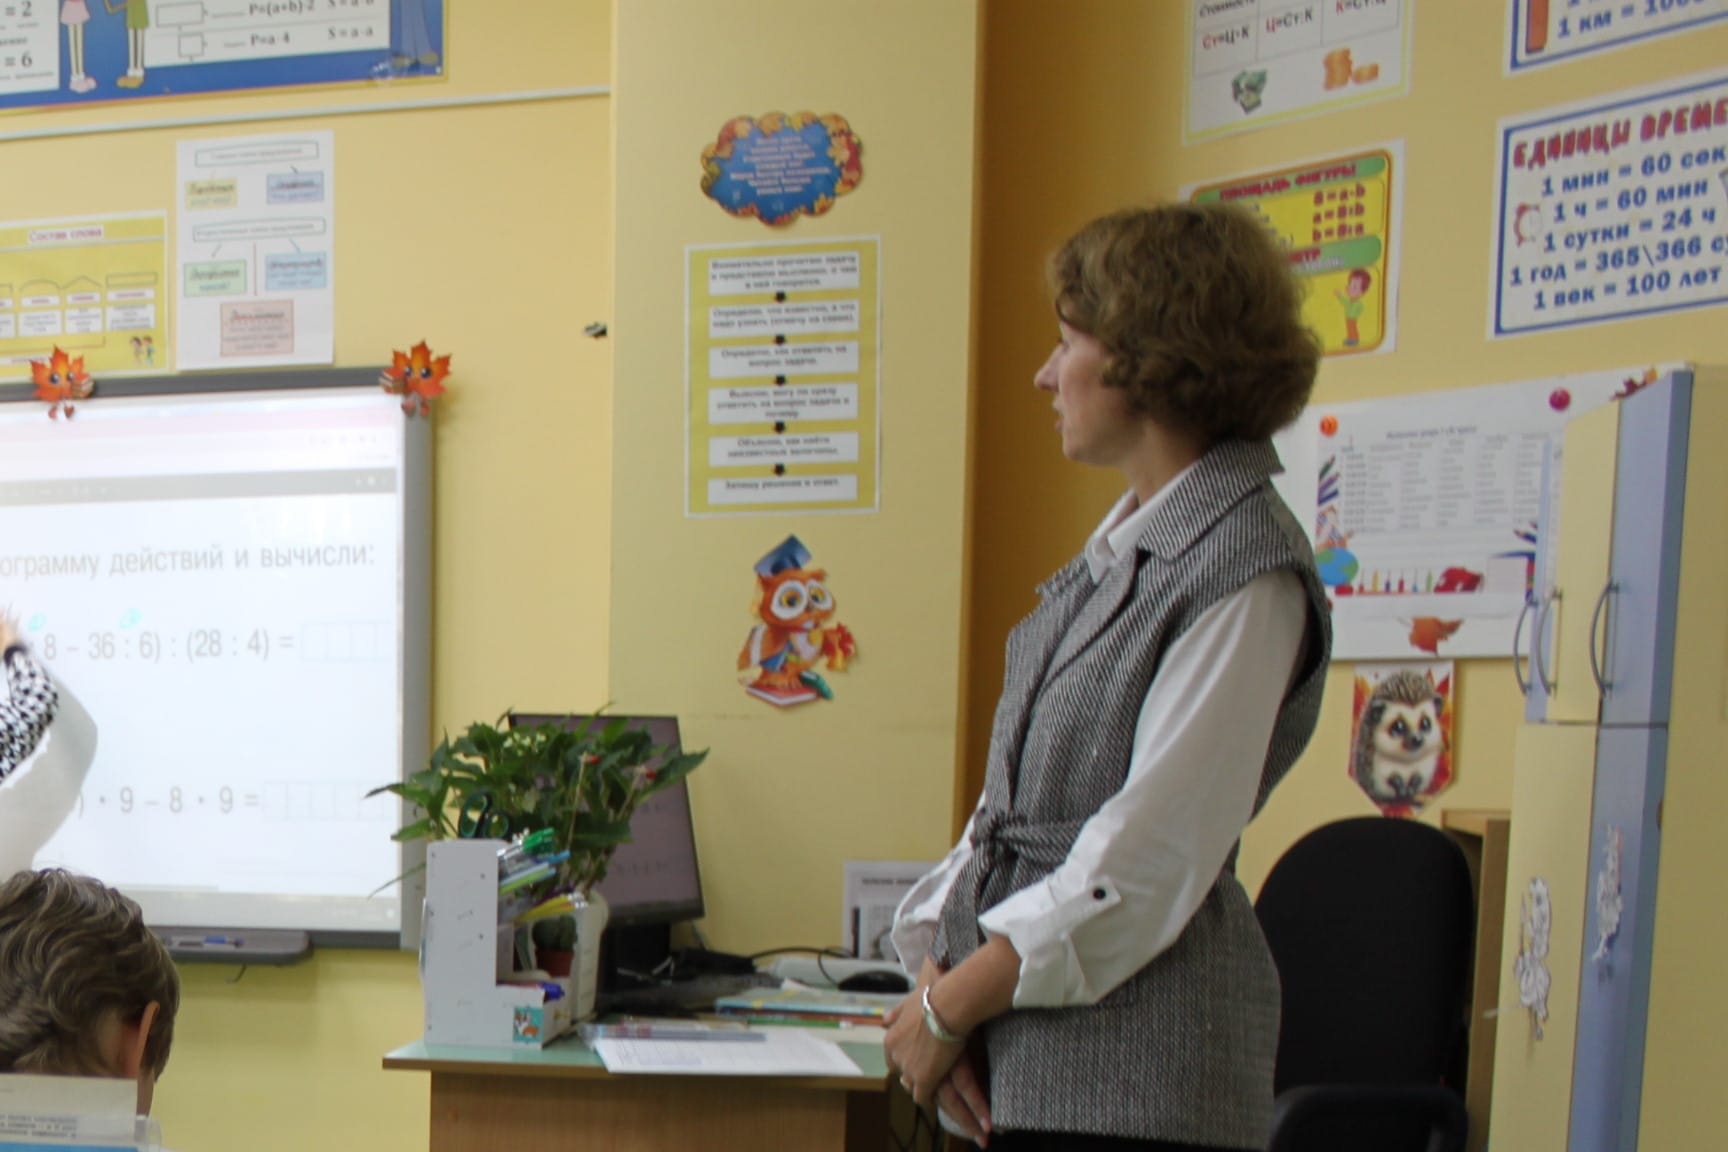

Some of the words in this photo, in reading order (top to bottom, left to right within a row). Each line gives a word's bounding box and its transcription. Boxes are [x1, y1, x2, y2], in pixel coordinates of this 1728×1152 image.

[21, 1, 32, 17] 2
[1558, 17, 1570, 38] 1
[1579, 10, 1612, 33] км
[21, 51, 33, 68] 6
[1513, 119, 1631, 170] ЕДИНИЦЫ
[1543, 177, 1553, 197] 1
[1562, 169, 1609, 193] мин
[1641, 153, 1672, 176] 60
[1554, 202, 1566, 222] 1
[1574, 202, 1587, 217] ч
[1617, 187, 1647, 211] 60
[1656, 180, 1709, 203] мин
[1544, 232, 1556, 252] 1
[1564, 223, 1630, 251] сутки
[1662, 208, 1692, 232] 24
[1701, 207, 1716, 223] ч
[1510, 267, 1522, 286] 1
[1530, 263, 1567, 284] год
[1534, 290, 1546, 310] 1
[1554, 286, 1595, 307] век
[1626, 270, 1671, 296] 100
[1679, 267, 1721, 288] лет
[109, 543, 224, 578] действий
[234, 548, 248, 569] и
[260, 542, 376, 569] вычисли:
[43, 633, 56, 660] 8
[87, 631, 116, 660] 36
[139, 630, 161, 663] 6)
[186, 628, 221, 662] (28
[247, 628, 271, 659] 4)
[120, 786, 134, 813] 9
[169, 786, 183, 813] 8
[221, 786, 234, 813] 9
